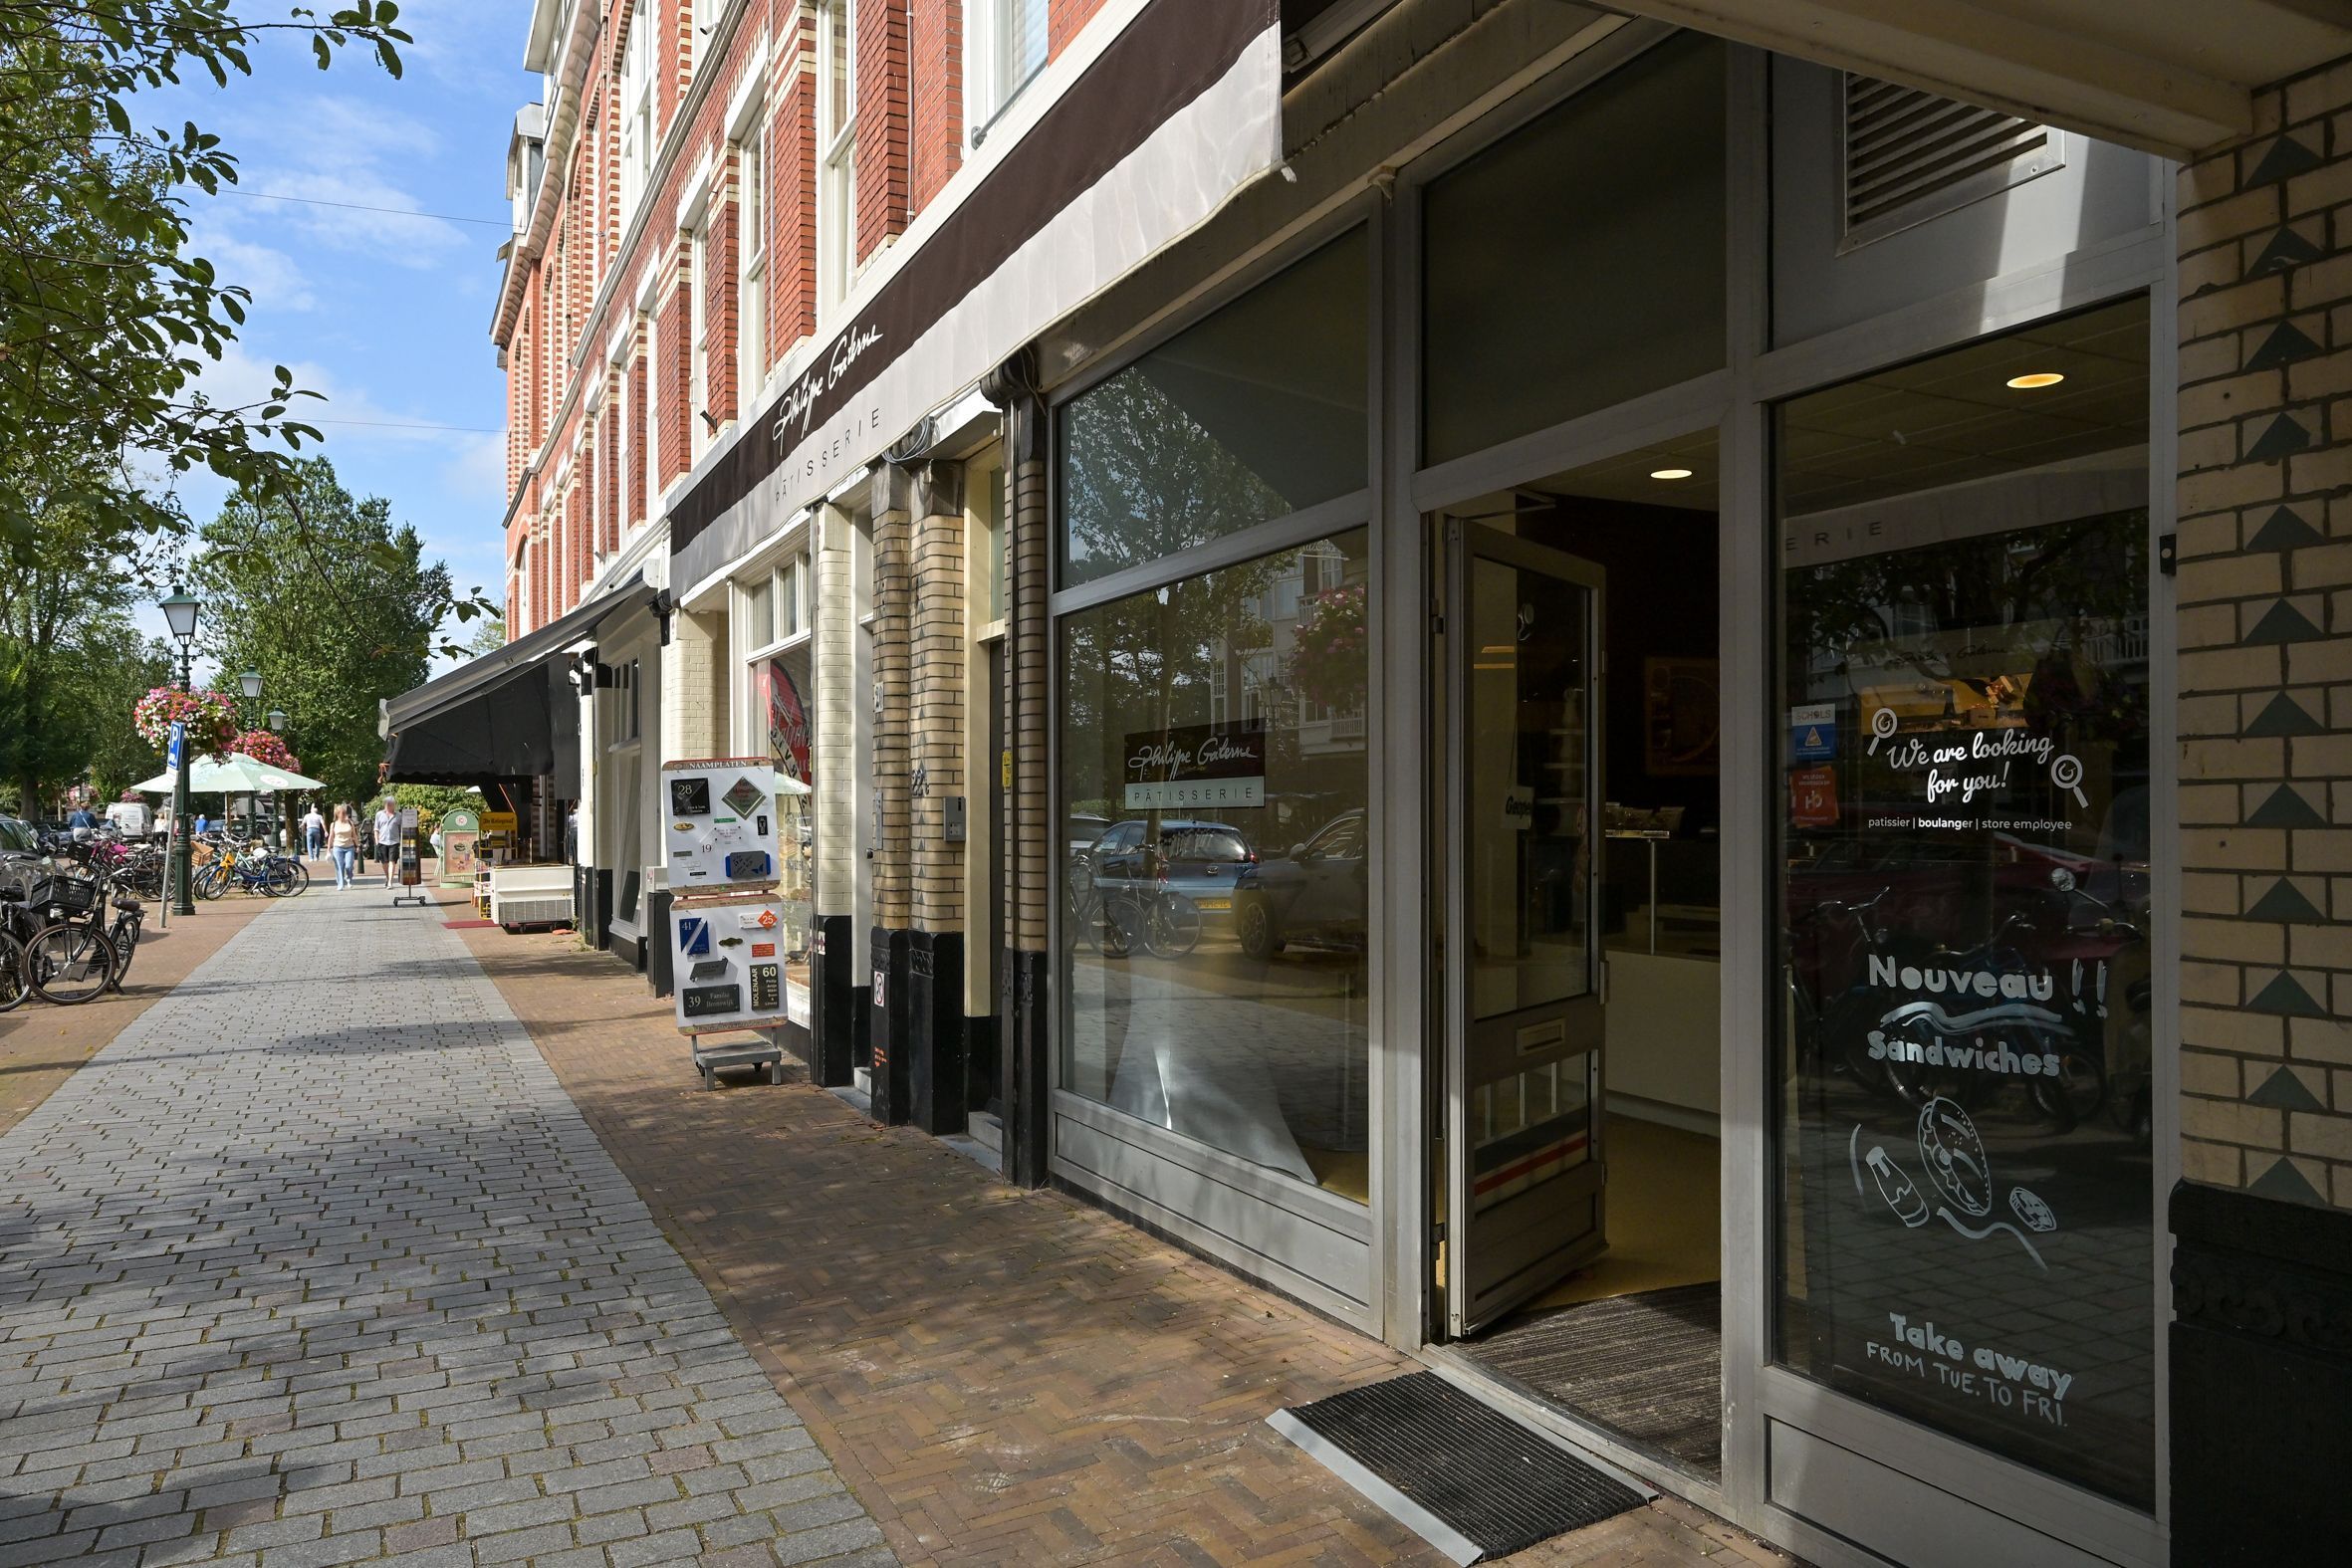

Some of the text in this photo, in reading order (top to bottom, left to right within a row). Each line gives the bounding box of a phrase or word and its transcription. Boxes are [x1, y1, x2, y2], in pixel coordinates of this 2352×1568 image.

[1886, 728, 2054, 769] We are looking
[689, 761, 747, 770] NAAMPLATEN
[678, 784, 693, 795] 28
[1927, 761, 2009, 803] for you!
[1868, 816, 2072, 832] patissier boulanger store employee
[701, 843, 712, 853] 19
[681, 921, 692, 931] 41
[762, 915, 774, 925] 25
[762, 966, 777, 978] 60
[1867, 954, 2054, 1002] Nouveau
[751, 968, 760, 1008] MOLENAAR
[688, 996, 701, 1008] 39
[1866, 1029, 2061, 1077] Sandwiches
[1889, 1311, 2074, 1401] Take away
[1866, 1340, 1926, 1378] FROM
[1933, 1362, 1981, 1398] TUE.
[1989, 1377, 2012, 1408] TO
